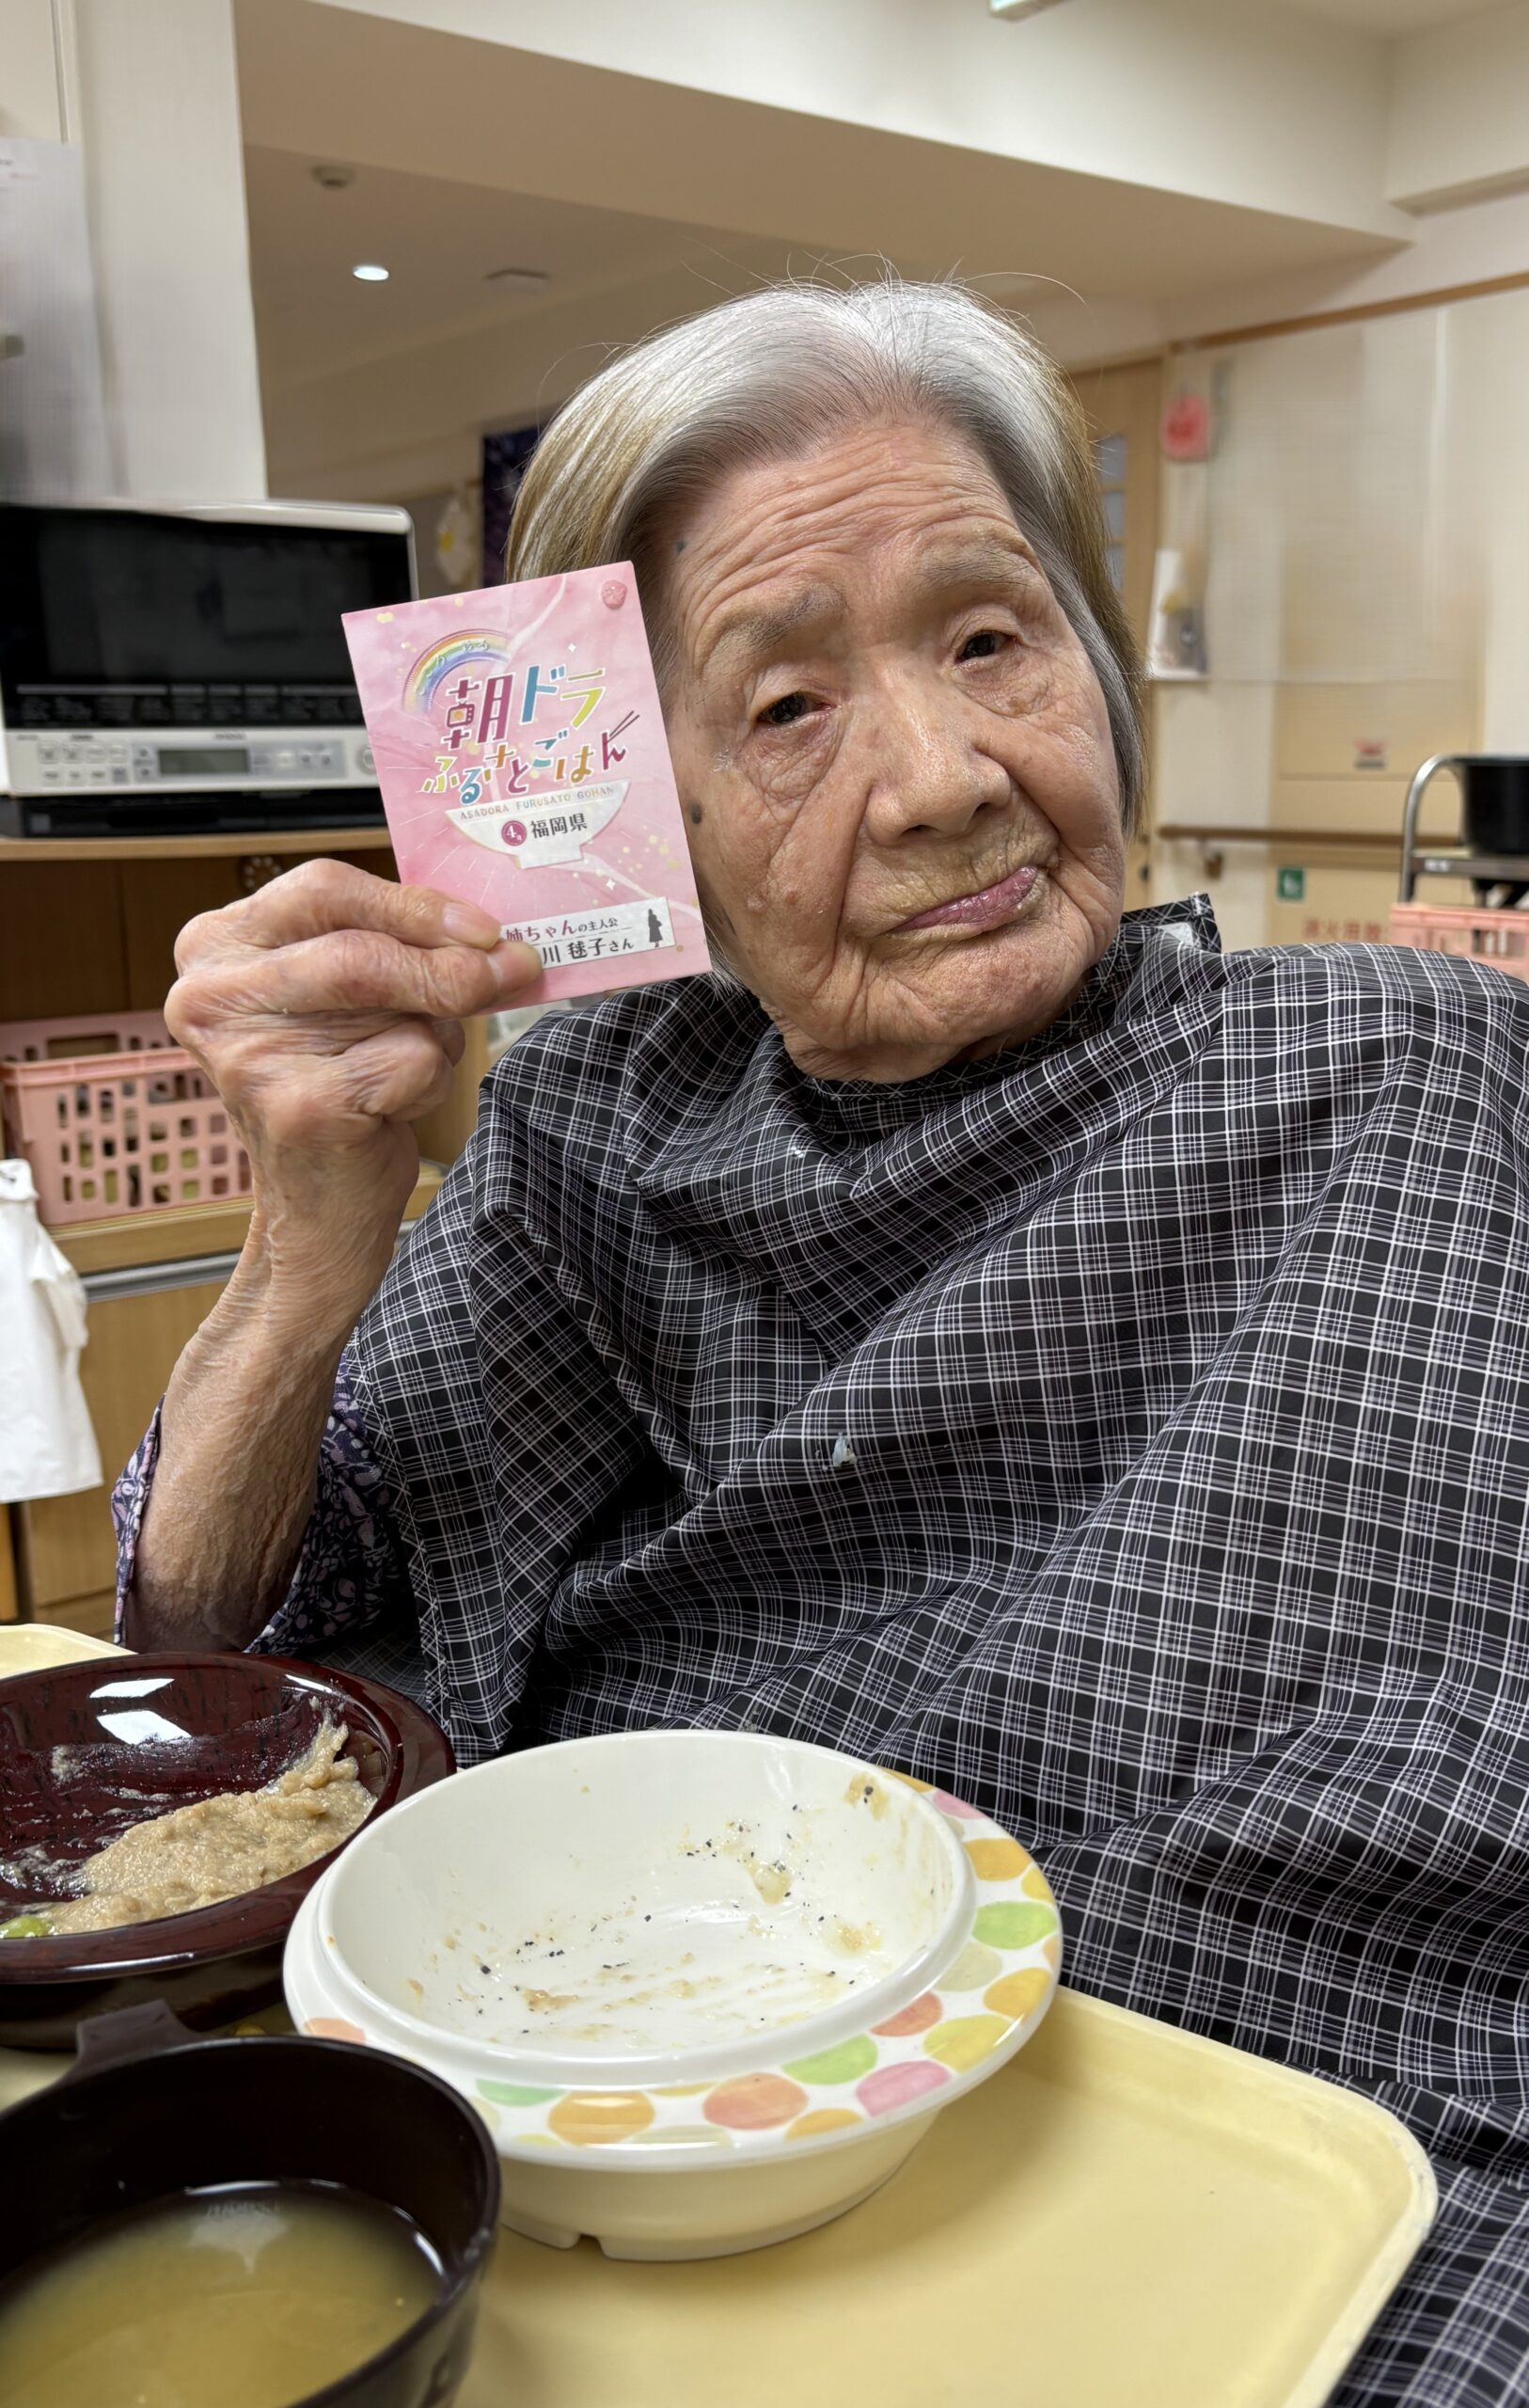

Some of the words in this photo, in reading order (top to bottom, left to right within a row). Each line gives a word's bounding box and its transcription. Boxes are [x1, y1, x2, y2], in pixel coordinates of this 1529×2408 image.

[442, 664, 605, 750] 朝ドラ
[422, 728, 627, 804] ふるさとごはん
[460, 803, 509, 820] ASADORA
[516, 794, 571, 811] FURUSATO
[576, 786, 614, 800] GOHAN
[530, 813, 588, 839] 福岡県
